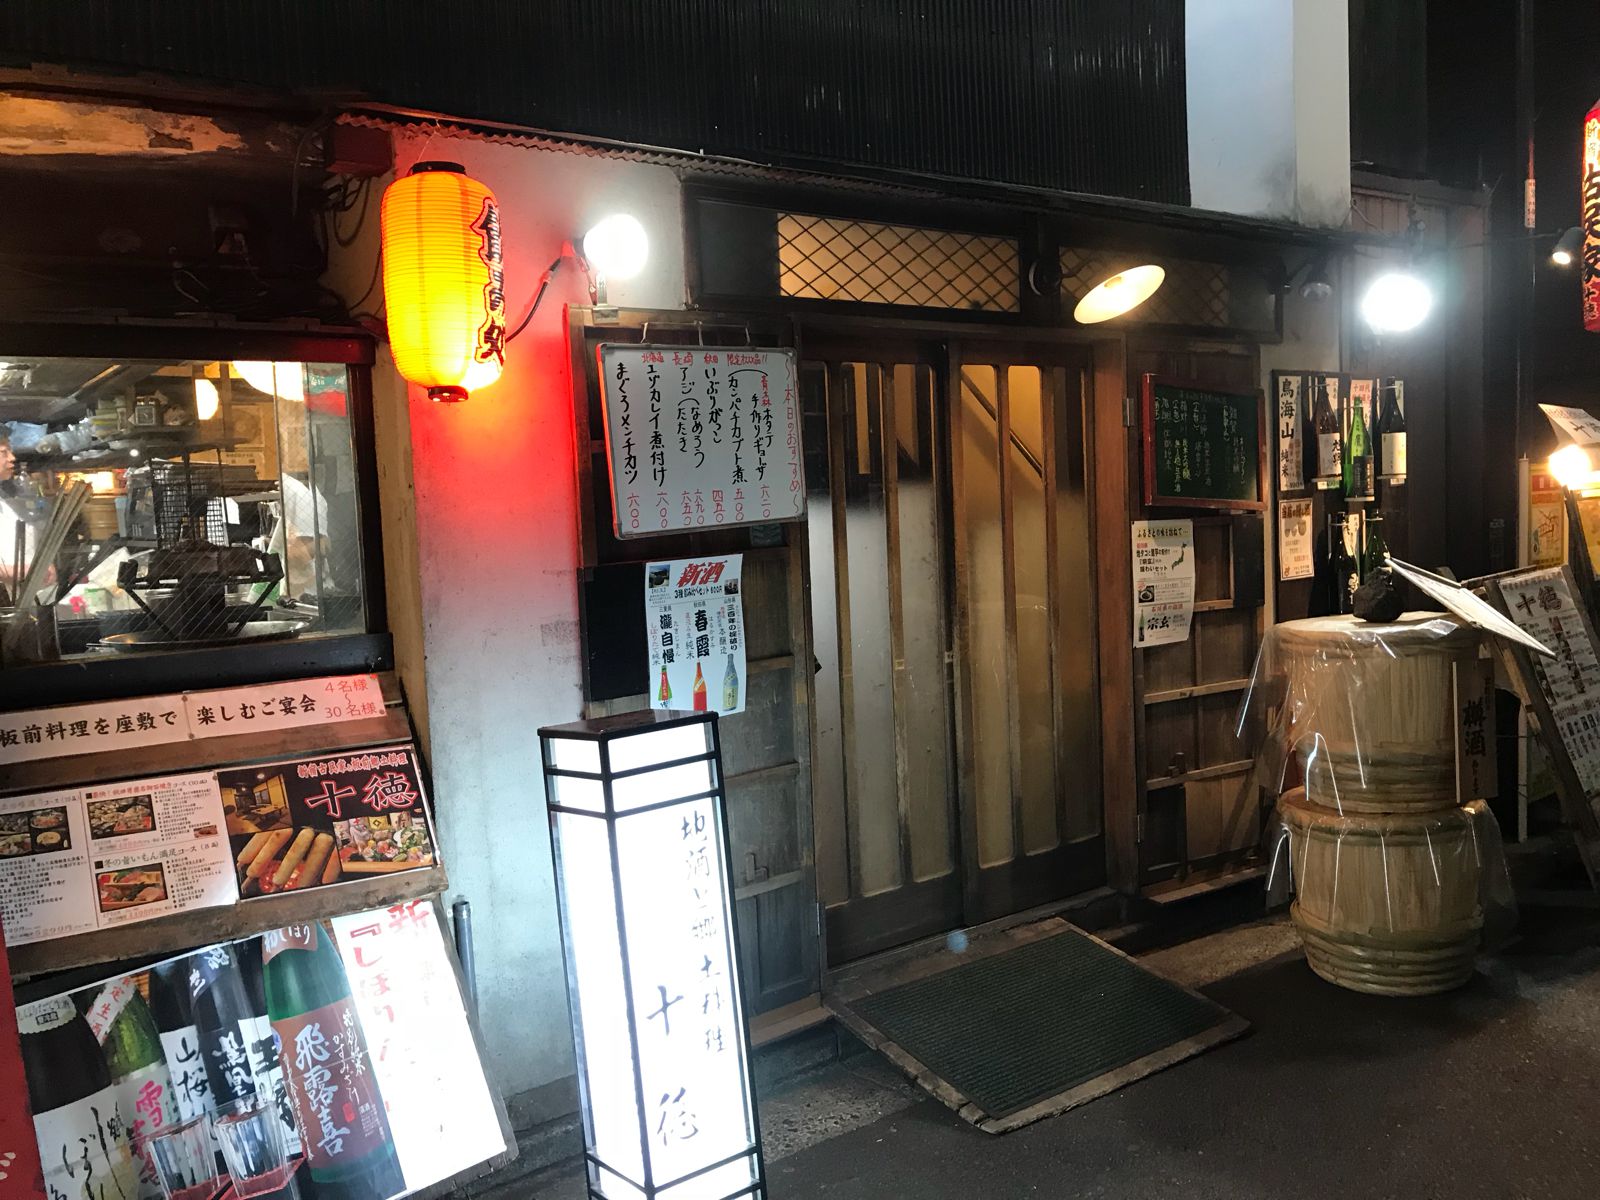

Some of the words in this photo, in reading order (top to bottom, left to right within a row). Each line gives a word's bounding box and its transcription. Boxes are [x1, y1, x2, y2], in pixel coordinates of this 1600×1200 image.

[672, 352, 694, 366] 長崎
[680, 367, 695, 395] アジ
[616, 362, 638, 486] まぐろメンチカツ
[646, 364, 667, 487] エゾカレイ煮付け
[676, 406, 688, 453] たたき
[704, 367, 723, 445] いぶりがっこ
[728, 376, 748, 485] カンパチカブト煮
[1280, 378, 1295, 440] 鳥海山
[690, 406, 705, 469] なめろう
[1280, 449, 1289, 477] 純米
[677, 560, 728, 587] 新酒
[660, 613, 675, 664] 瀧自慢
[694, 609, 710, 658] 春霞
[0, 710, 177, 748] 板前料理を座敷で
[197, 694, 317, 726] 楽しむご宴会
[324, 702, 377, 719] 30名様
[303, 772, 419, 818] 十徳
[294, 1023, 351, 1157] 飛露喜
